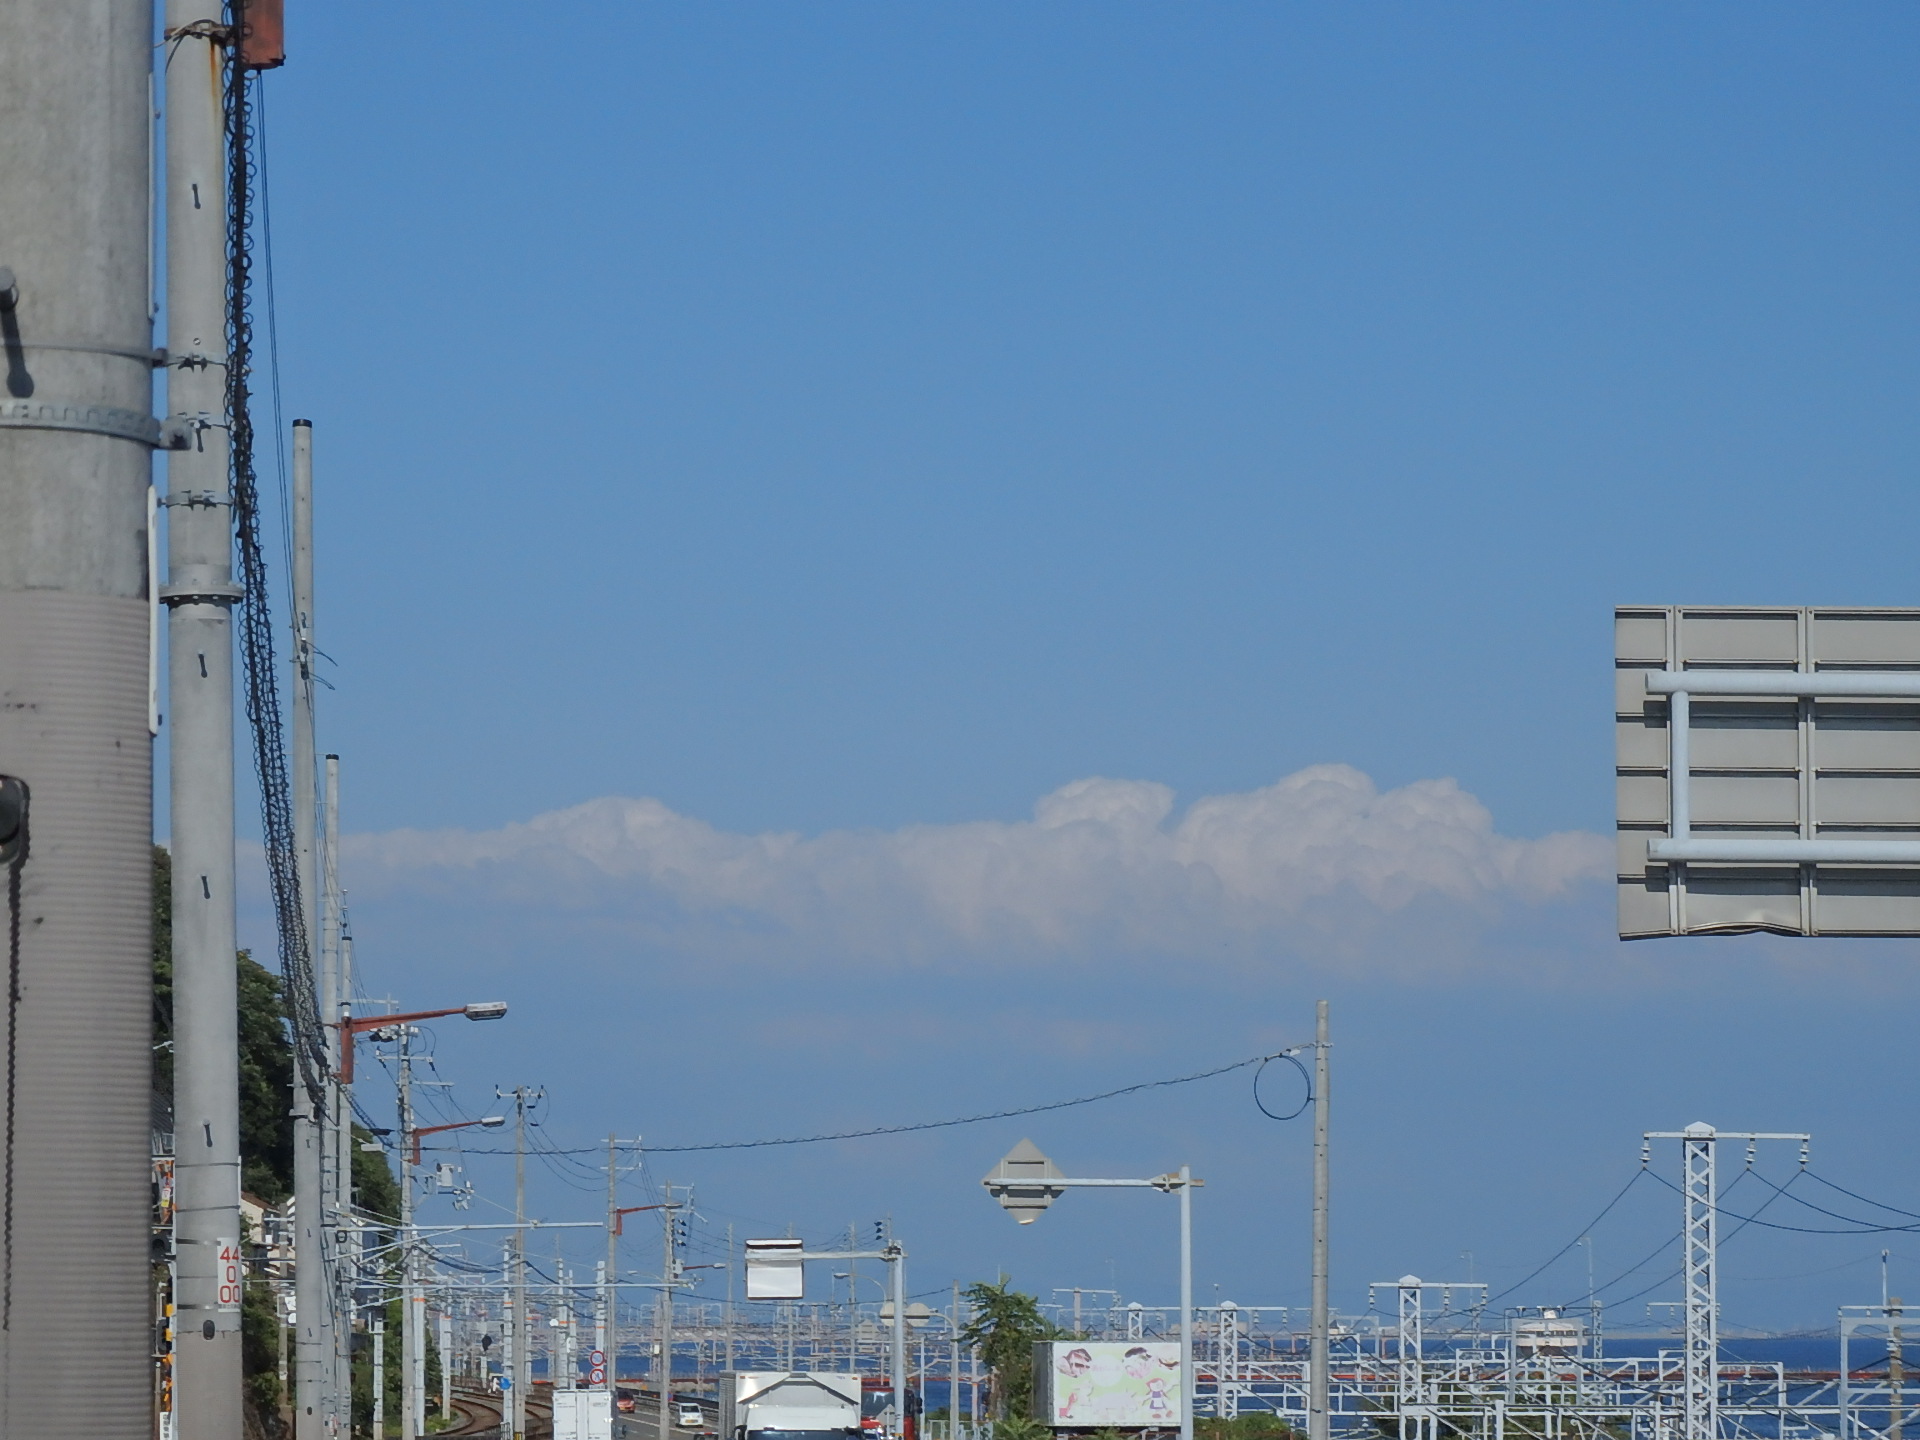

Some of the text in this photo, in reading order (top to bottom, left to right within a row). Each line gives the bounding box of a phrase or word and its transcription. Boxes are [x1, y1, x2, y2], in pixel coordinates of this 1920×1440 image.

[220, 1246, 240, 1263] 44
[226, 1265, 236, 1283] 0
[220, 1285, 240, 1303] 00
